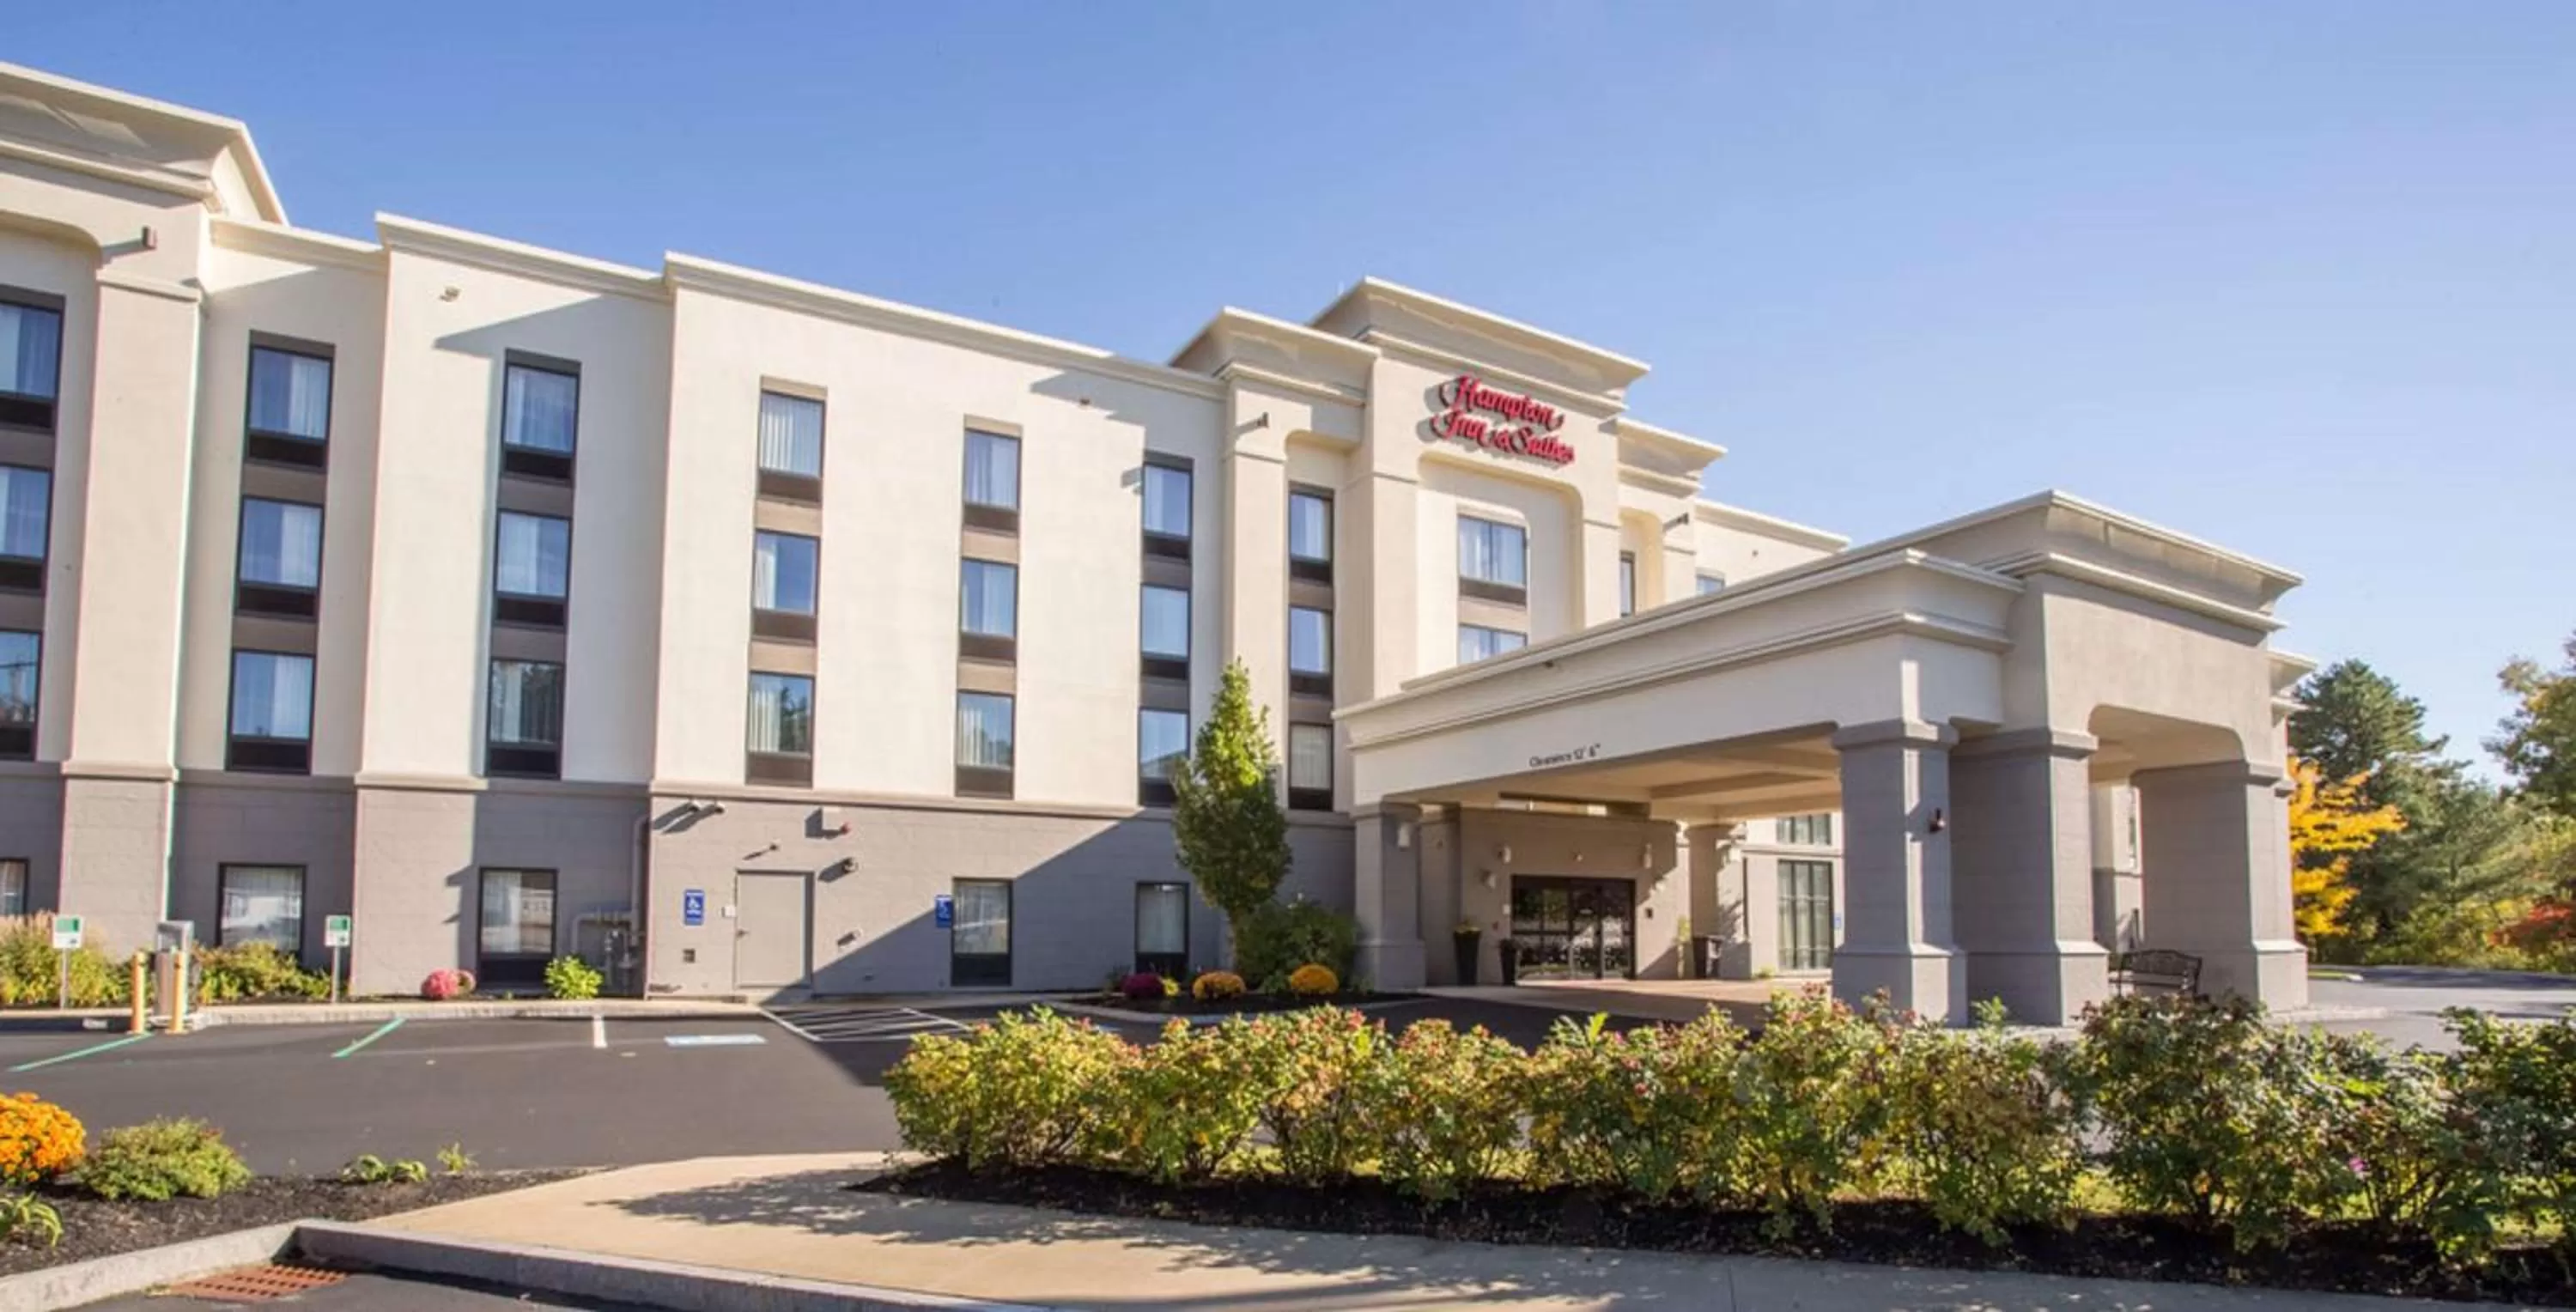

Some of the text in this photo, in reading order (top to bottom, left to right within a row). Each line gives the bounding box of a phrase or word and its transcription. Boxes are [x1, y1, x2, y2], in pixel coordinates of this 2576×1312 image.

[1438, 374, 1564, 430] Hampton
[1430, 410, 1489, 448] Inn
[1510, 427, 1575, 465] Suites
